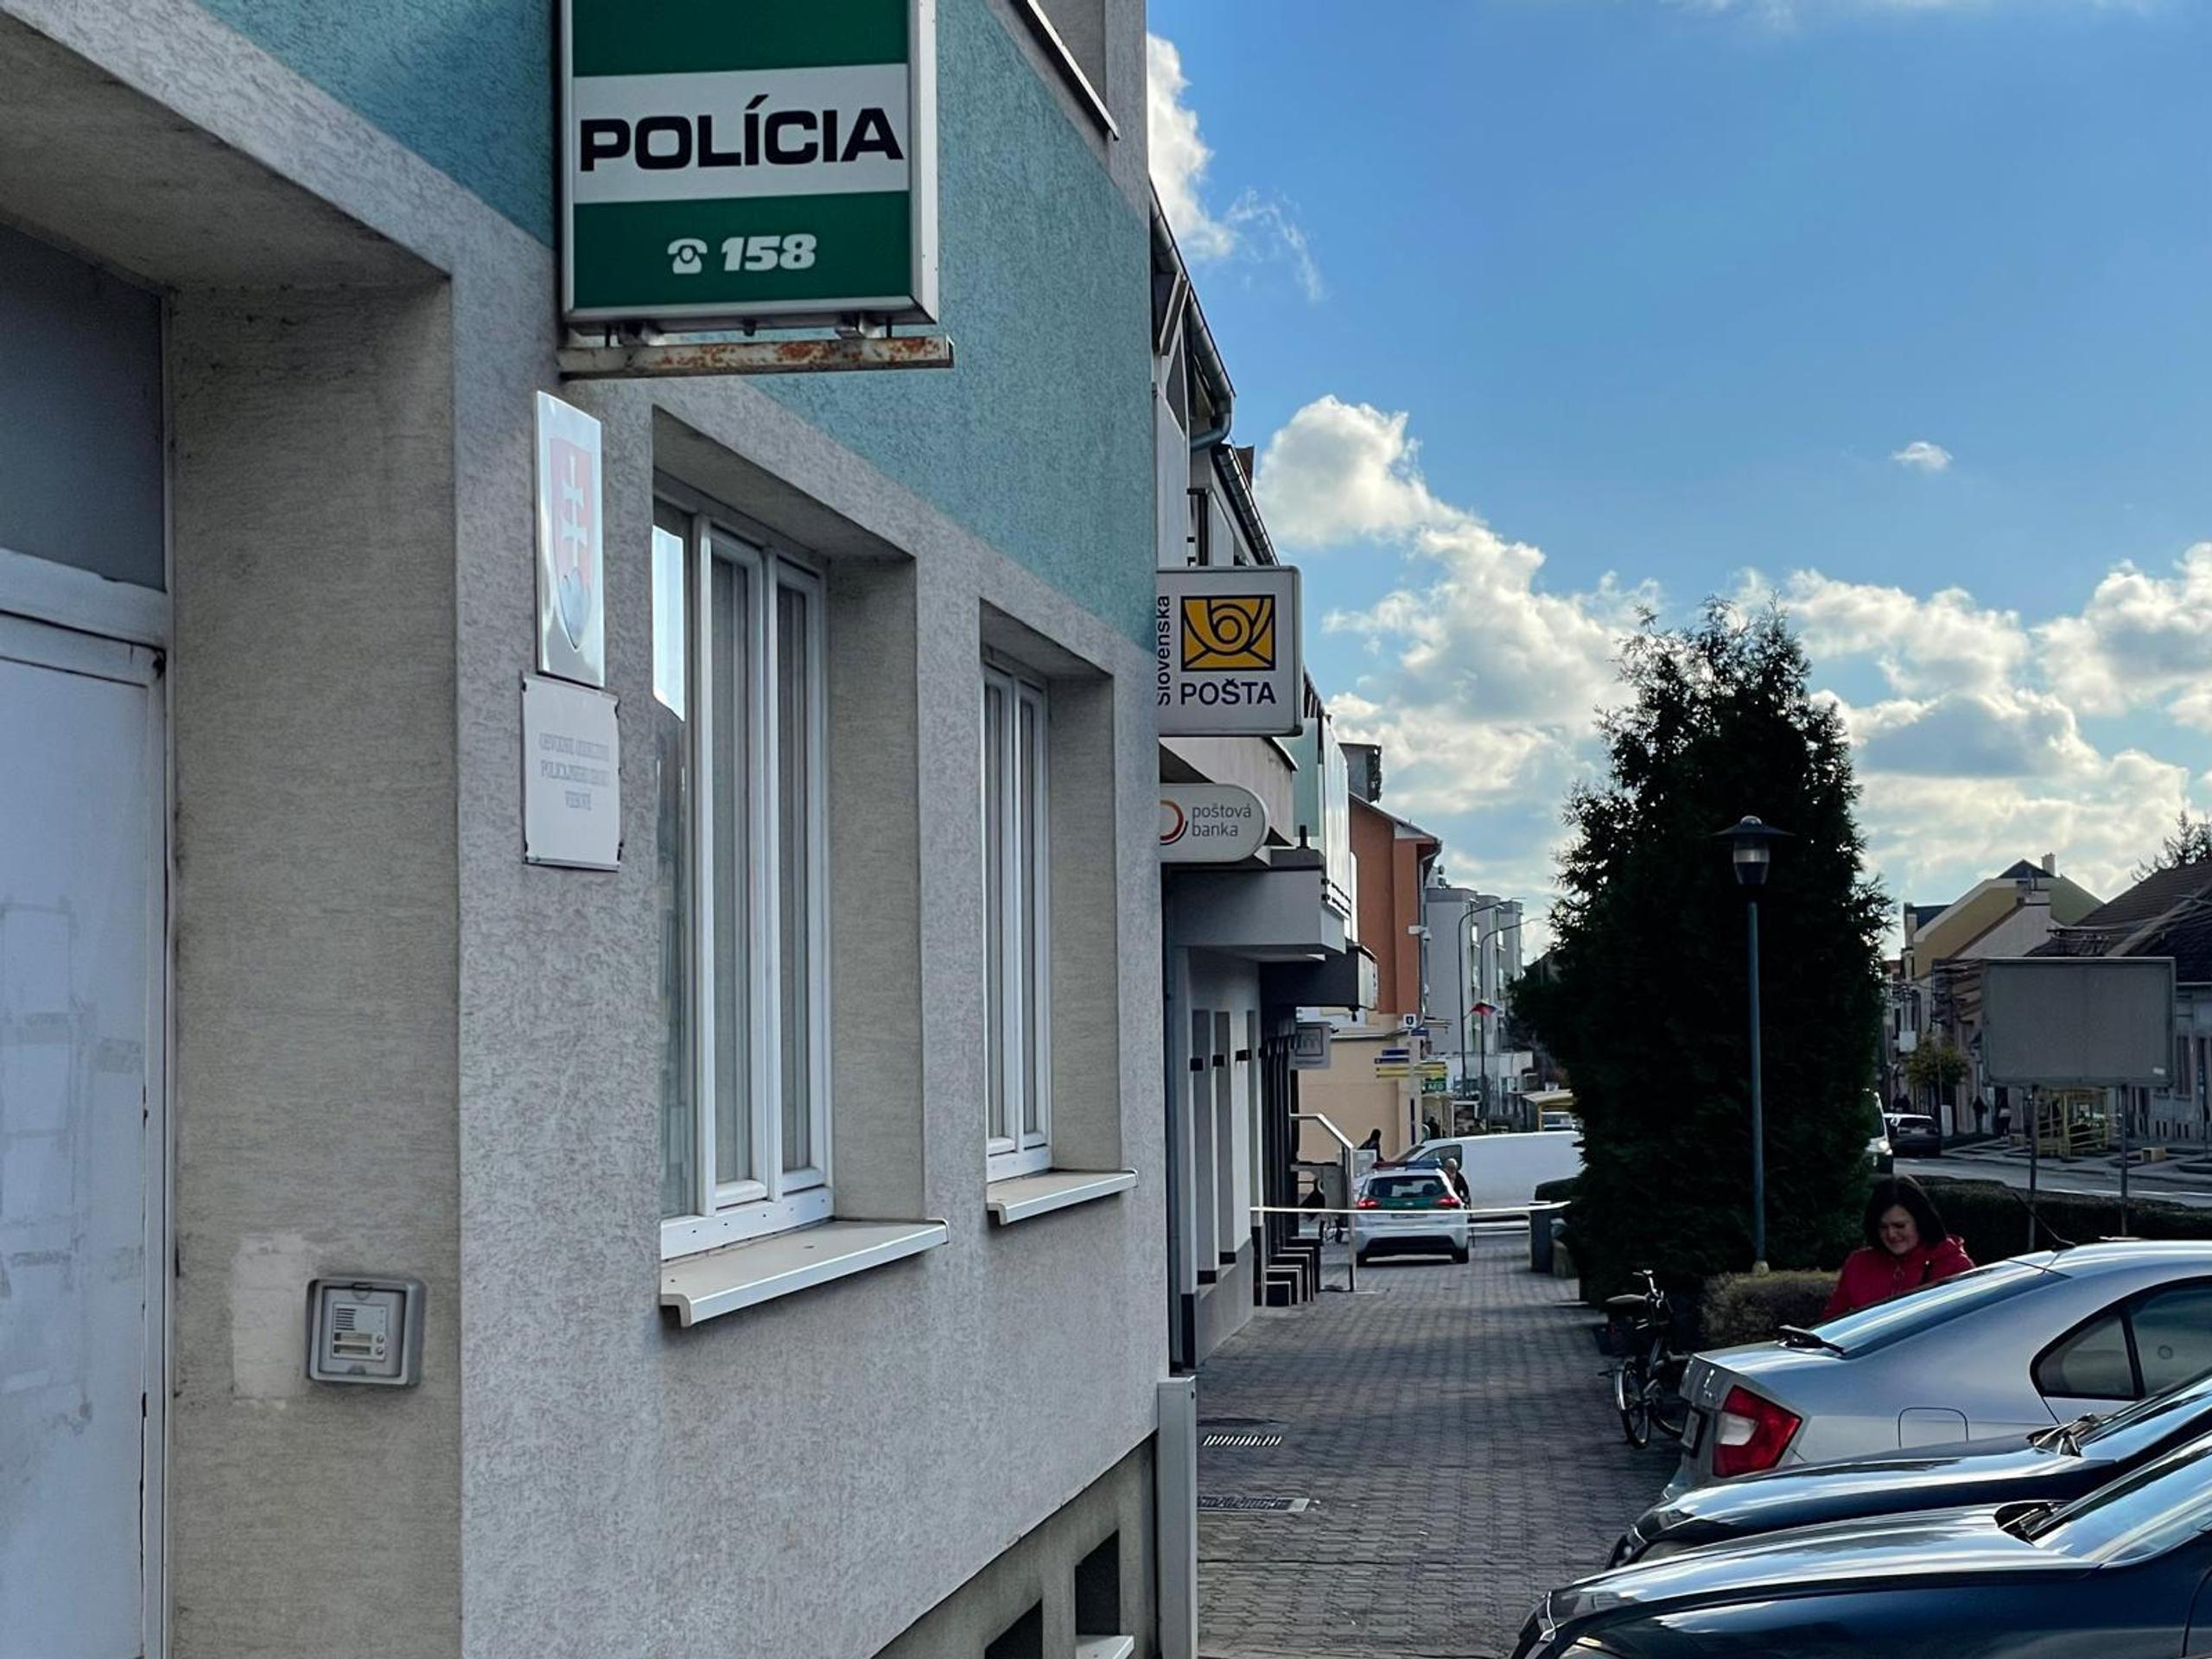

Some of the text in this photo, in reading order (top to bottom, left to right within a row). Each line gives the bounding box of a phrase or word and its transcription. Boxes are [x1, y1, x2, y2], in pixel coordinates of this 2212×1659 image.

[580, 93, 904, 172] POLÍCIA
[721, 232, 817, 272] 158
[1180, 678, 1276, 706] POŠTA
[1192, 803, 1252, 820] poštová
[1192, 822, 1239, 837] banka
